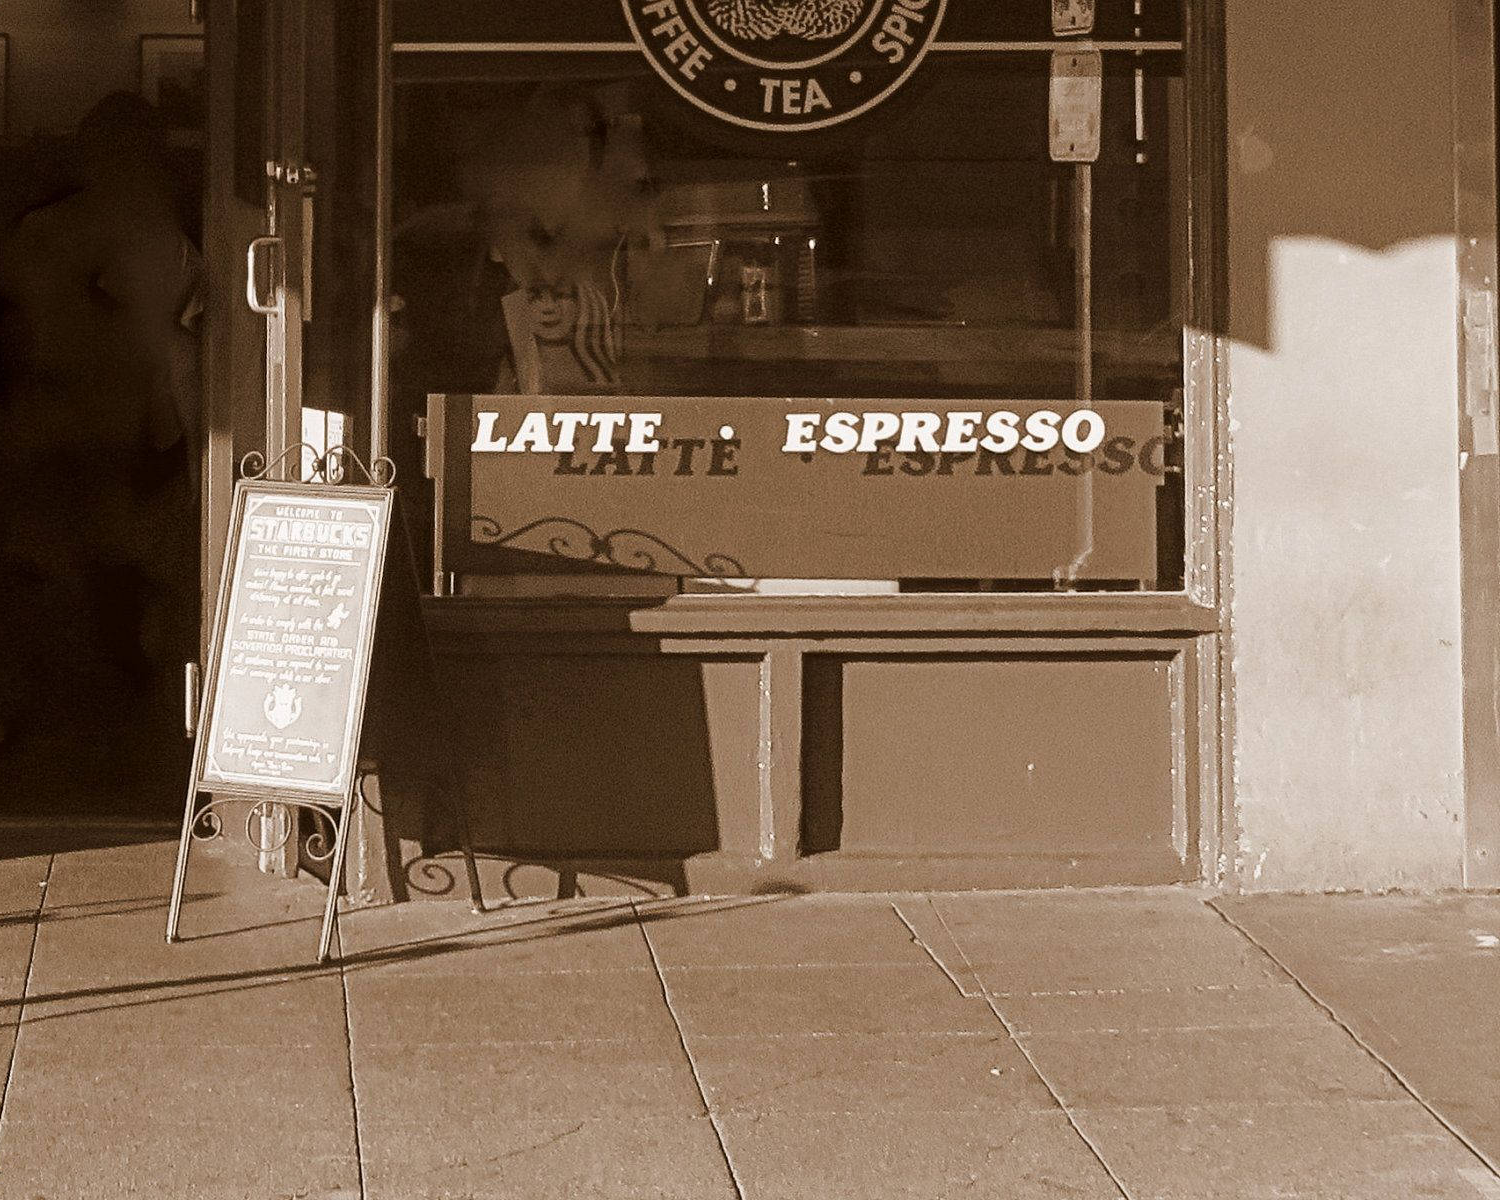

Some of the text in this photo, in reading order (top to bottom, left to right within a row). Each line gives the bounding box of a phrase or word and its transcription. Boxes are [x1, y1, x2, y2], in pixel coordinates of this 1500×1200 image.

[760, 78, 832, 114] TEA
[471, 410, 1105, 453] LATTE ESPRESSO
[250, 517, 370, 548] STARBUCKS
[258, 544, 354, 559] THE FIRST STORE
